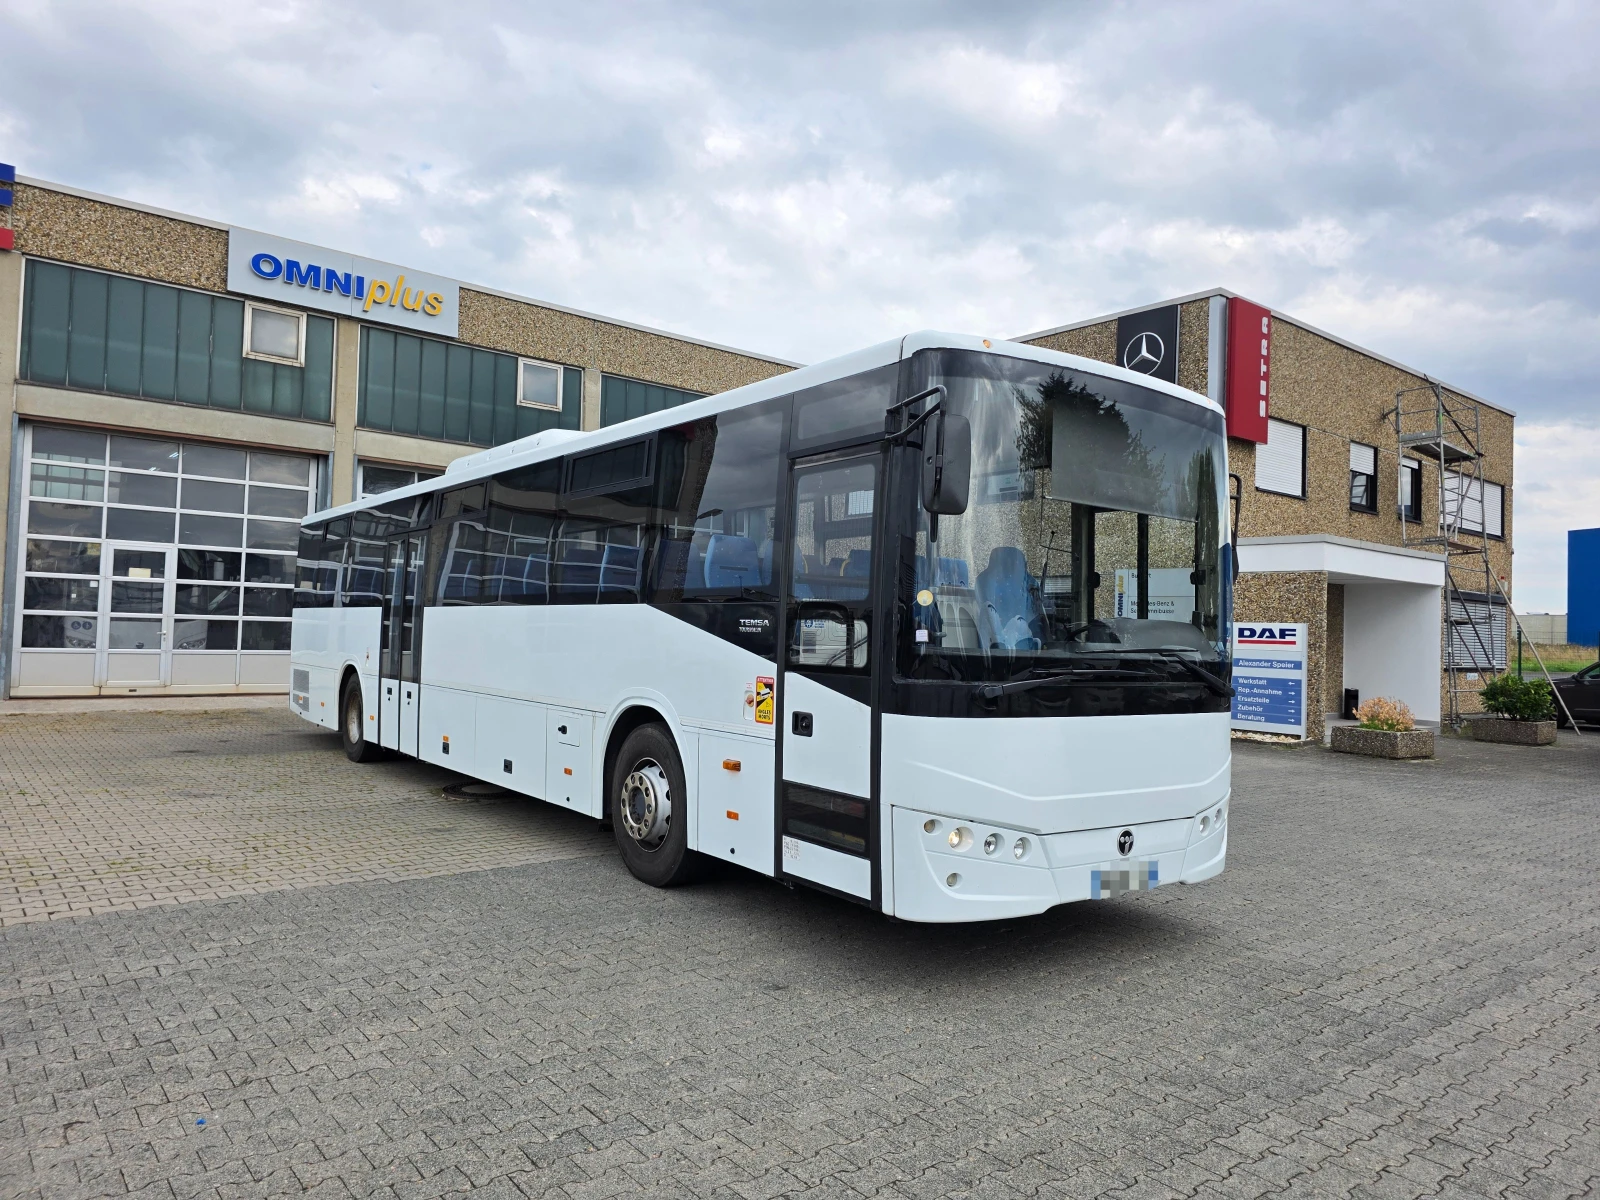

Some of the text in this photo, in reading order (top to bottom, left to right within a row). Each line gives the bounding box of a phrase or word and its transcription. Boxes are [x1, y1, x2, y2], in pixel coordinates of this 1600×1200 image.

[251, 253, 444, 316] OMNIplus
[739, 619, 770, 627] TEMSA
[1238, 628, 1297, 639] DAF
[1238, 677, 1267, 685] Werkstatt
[1238, 687, 1283, 695] Rep.-Annahme
[1237, 695, 1270, 704] Ersatzteile
[1237, 704, 1263, 712] Zubehör
[1237, 713, 1265, 722] Beratung
